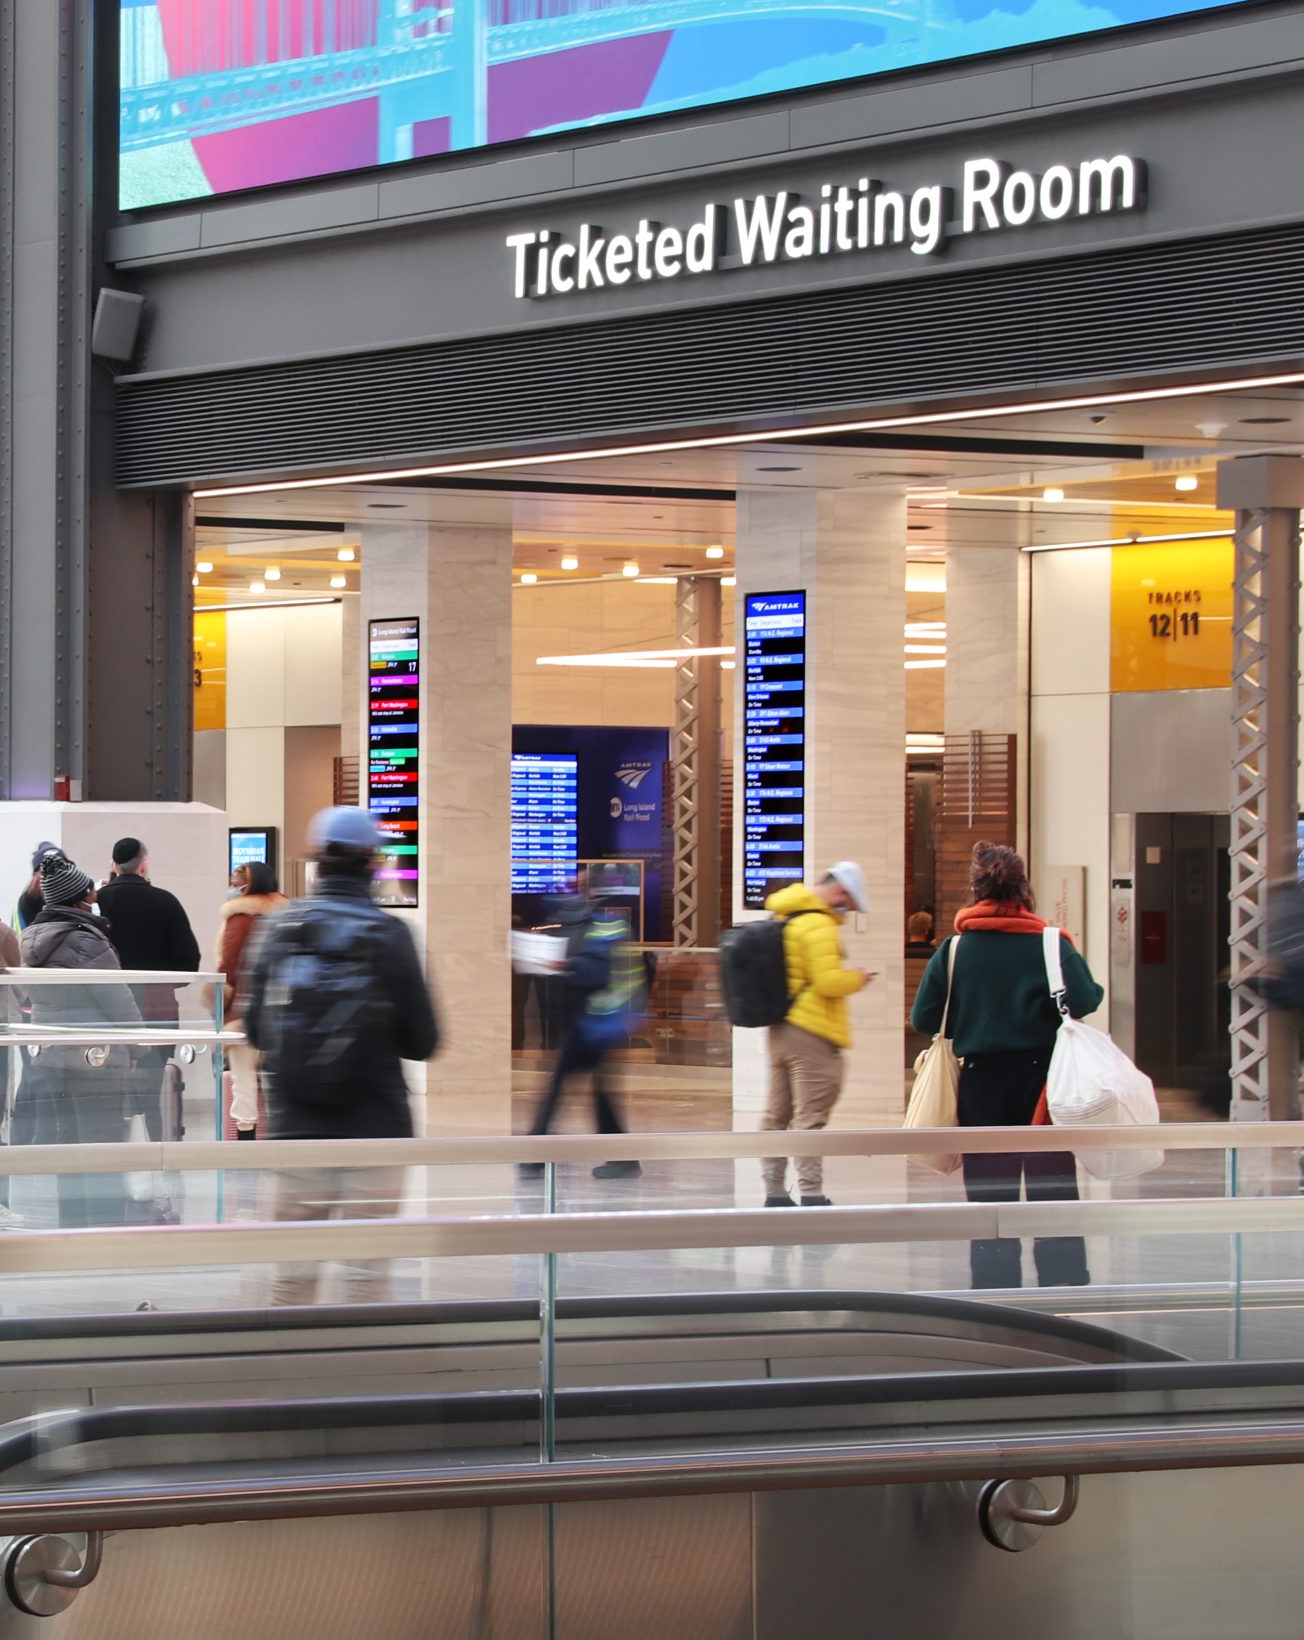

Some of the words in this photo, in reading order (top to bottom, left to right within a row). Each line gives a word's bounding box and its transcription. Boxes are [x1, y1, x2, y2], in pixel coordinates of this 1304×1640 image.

[505, 204, 715, 299] Ticketed
[734, 177, 941, 255] Waiting
[962, 154, 1135, 232] Room
[1148, 590, 1201, 604] TRACKS
[763, 602, 799, 611] AMTRAK
[408, 661, 417, 672] 17
[624, 804, 638, 813] Long
[639, 803, 656, 811] Island
